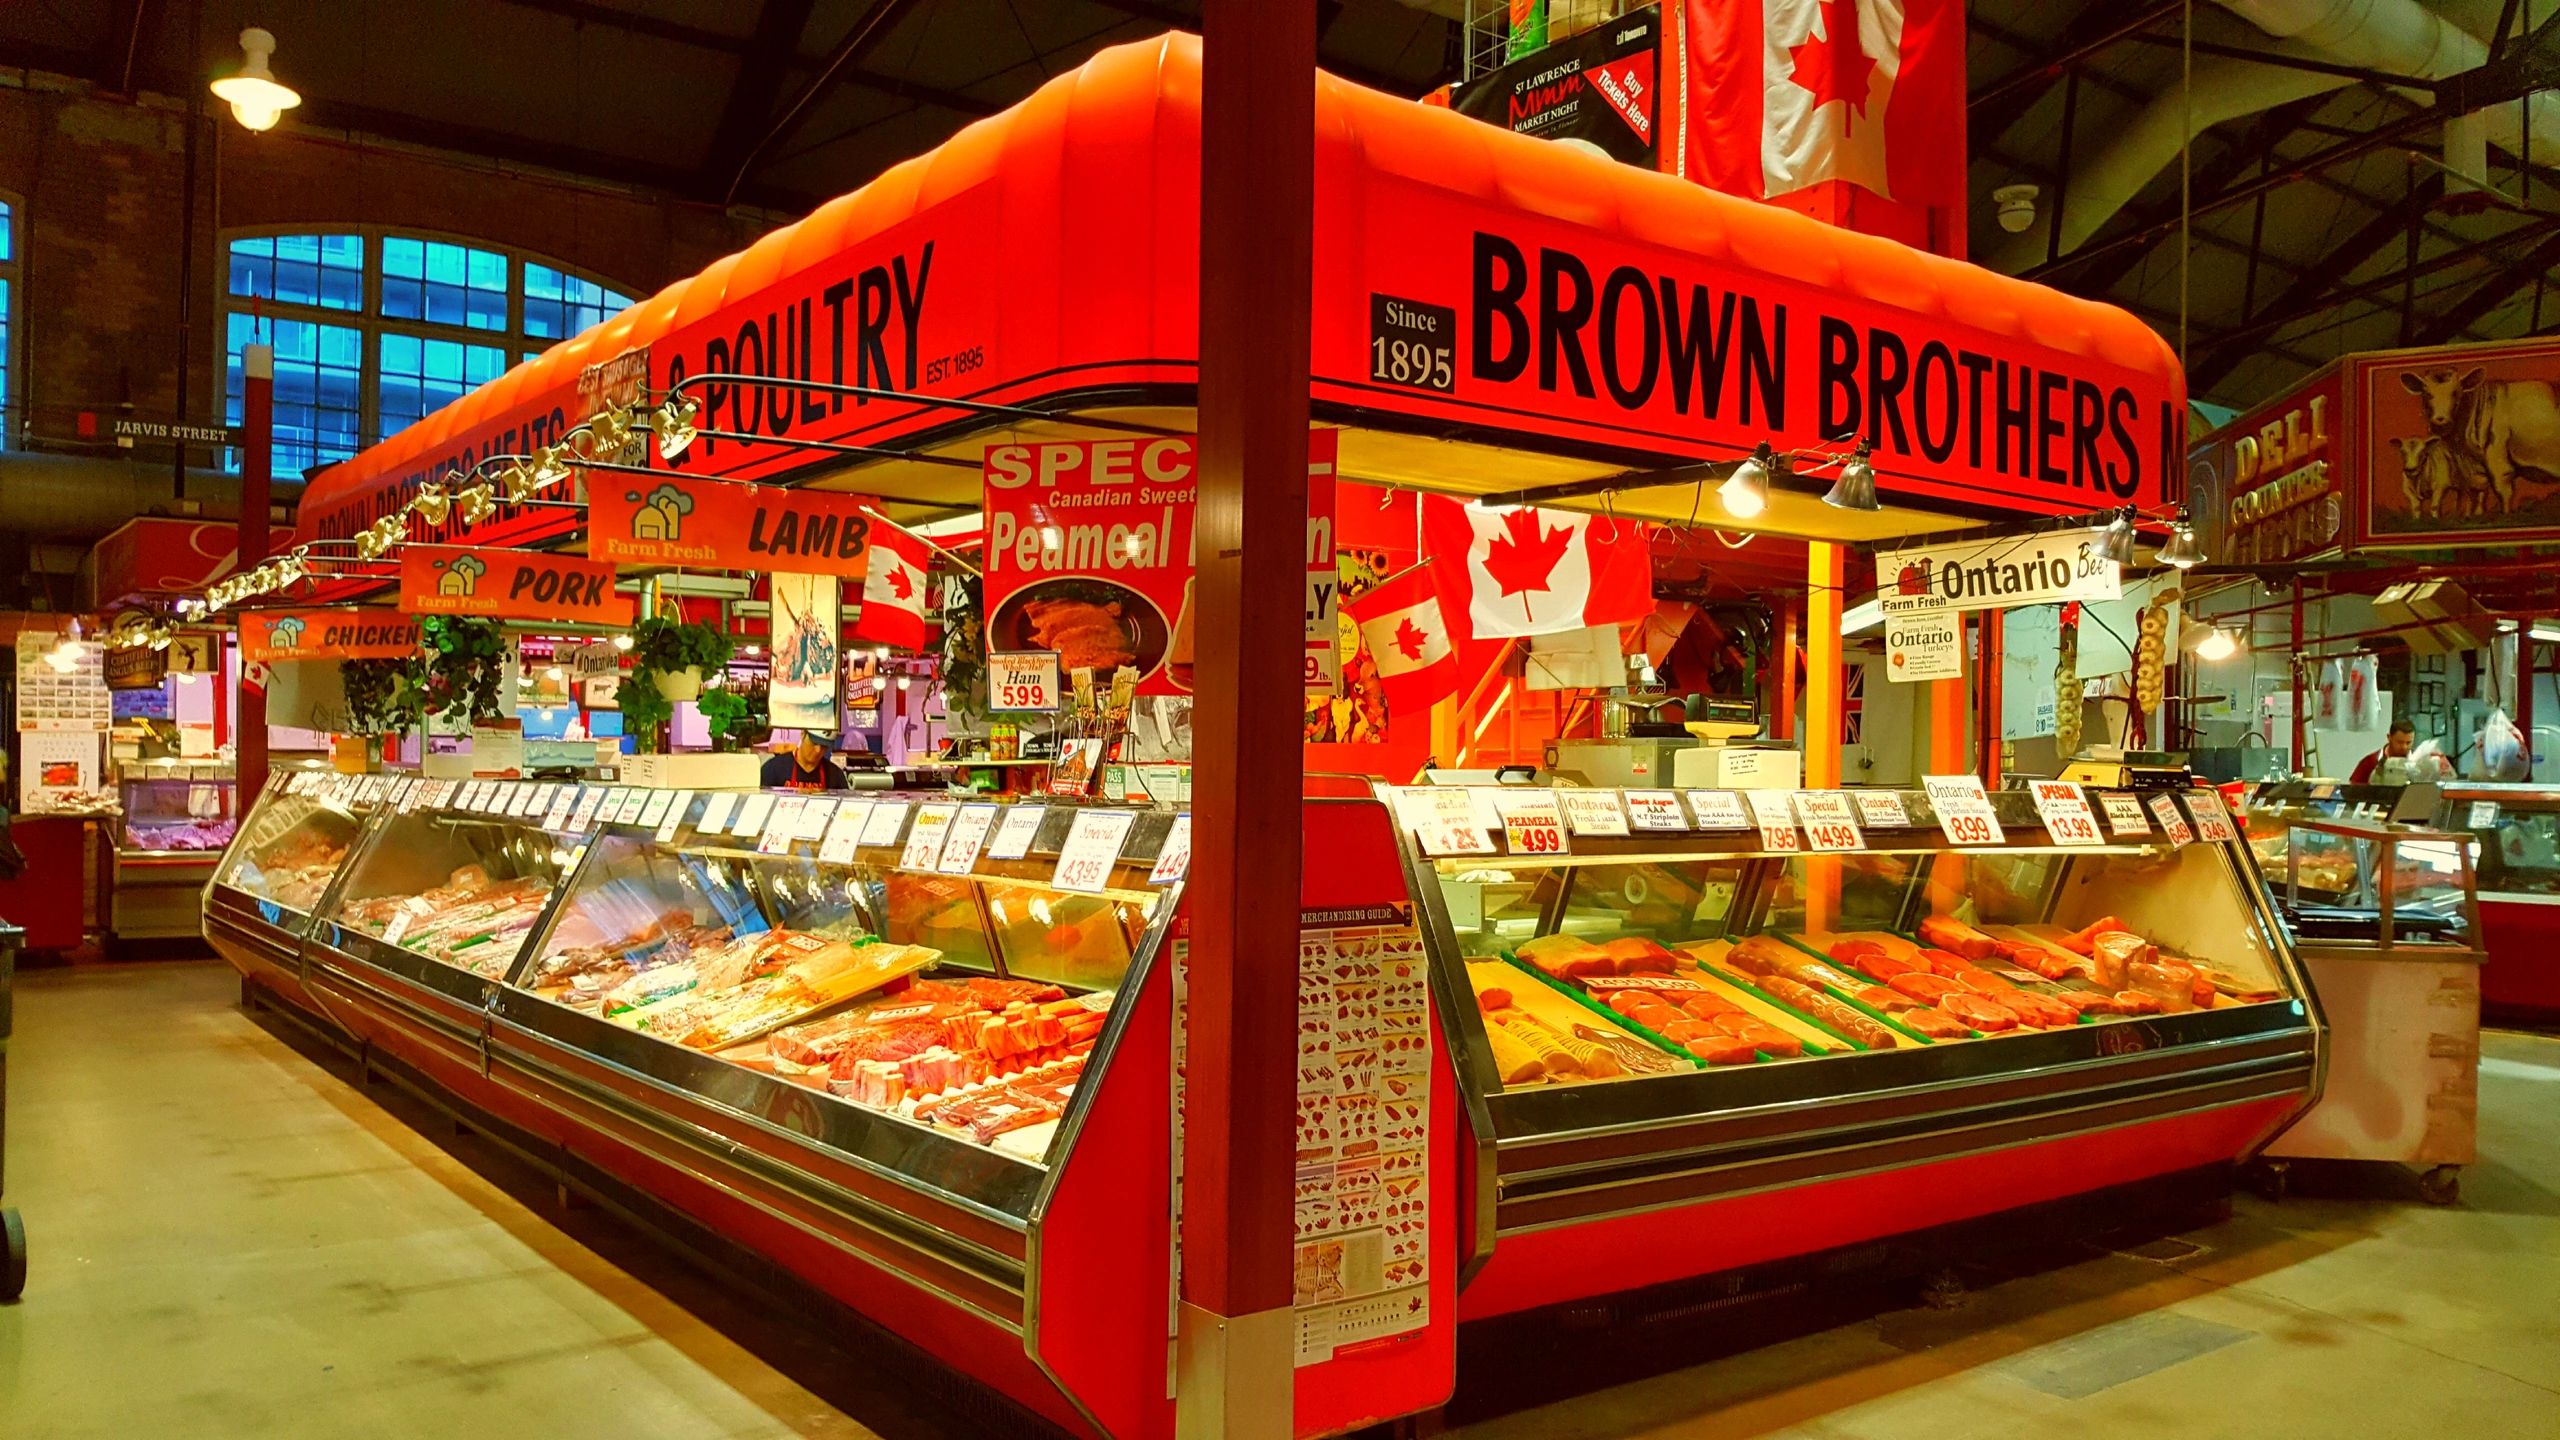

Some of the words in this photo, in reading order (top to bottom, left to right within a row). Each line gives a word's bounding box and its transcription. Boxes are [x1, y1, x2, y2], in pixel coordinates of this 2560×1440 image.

[1527, 59, 1580, 91] LAWRENCE
[1624, 71, 1644, 99] Buy
[1598, 69, 1629, 110] Tickets
[1626, 101, 1649, 132] Here
[1514, 113, 1549, 133] MARKET
[1551, 100, 1579, 120] NIGHT
[1385, 301, 1437, 333] Since
[706, 241, 935, 456] POULTRY
[926, 357, 951, 385] EST.
[952, 346, 984, 377] 1895
[1372, 336, 1452, 389] 1895
[1471, 230, 1787, 432] BROWN
[1818, 314, 2140, 500] BROTHERS
[114, 421, 167, 437] JARVIS
[171, 426, 228, 442] STREET
[2235, 394, 2329, 486] DELI
[1049, 489, 1132, 508] Canadian
[1139, 486, 1196, 505] Sweet
[748, 507, 869, 559] LAMB
[989, 506, 1174, 573] Peameal
[607, 538, 658, 557] Farm
[662, 541, 717, 561] Fresh
[1942, 550, 2071, 600] Ontario
[509, 566, 609, 607] PORK
[416, 595, 457, 609] Farm
[460, 596, 498, 609] Fresh
[1882, 599, 1914, 612] Farm
[1918, 594, 1947, 609] Fresh
[323, 625, 419, 647] CHICKEN
[1890, 627, 1953, 647] Ontario
[1922, 643, 1954, 653] Turkeys
[848, 677, 874, 691] CERTIFIE
[1007, 671, 1041, 684] Ham
[1106, 770, 1122, 783] PASS
[1927, 781, 1975, 799] Ontario
[2038, 784, 2079, 800] SPECIAL
[1696, 796, 1731, 810] Special
[1804, 799, 1839, 815] Special
[918, 811, 948, 826] Ontario
[1006, 817, 1038, 829] Ontario
[1506, 816, 1558, 827] PEAMEAL
[1951, 816, 1991, 842] 8.99
[2052, 817, 2093, 838] 13.99
[2202, 820, 2227, 839] 3.49
[1763, 826, 1796, 849] 7.95
[1812, 826, 1855, 848] 14.99
[1301, 909, 1366, 924] MERCHANDISING
[1367, 908, 1392, 919] GUIDE
